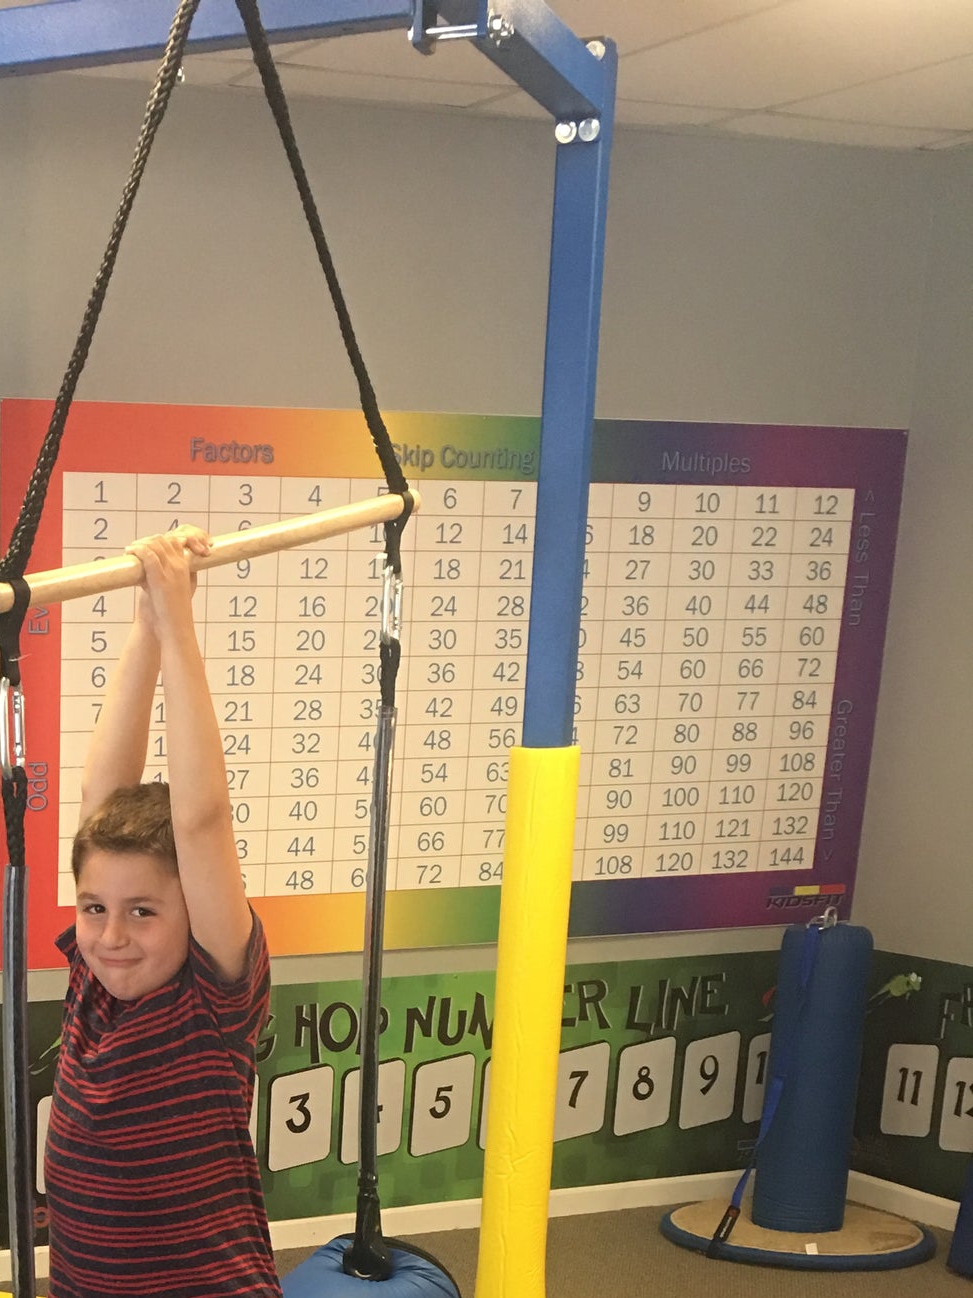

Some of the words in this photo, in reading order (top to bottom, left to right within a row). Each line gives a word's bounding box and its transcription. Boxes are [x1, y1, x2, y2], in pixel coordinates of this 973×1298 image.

[190, 437, 274, 464] Factors
[440, 443, 535, 475] Counting
[662, 451, 752, 476] Multiples
[95, 481, 108, 503] 1
[167, 482, 181, 504] 2
[239, 484, 252, 505] 3
[308, 485, 322, 506] 4
[444, 488, 456, 509] 6
[511, 489, 522, 509] 7
[639, 492, 651, 512] 9
[696, 493, 720, 513] 10
[755, 494, 779, 513] 11
[814, 495, 838, 514] 12
[94, 518, 107, 540] 2
[436, 523, 462, 543] 12
[503, 524, 527, 544] 14
[629, 525, 654, 545] 18
[692, 526, 718, 546] 20
[751, 527, 777, 546] 22
[810, 528, 832, 547] 24
[855, 512, 875, 563] Less
[237, 558, 250, 579] 9
[300, 558, 328, 579] 12
[434, 559, 460, 579] 18
[499, 559, 525, 579] 21
[626, 560, 650, 579] 27
[689, 560, 715, 580] 30
[748, 561, 773, 580] 33
[807, 561, 831, 580] 36
[92, 596, 107, 617] 4
[229, 596, 257, 617] 12
[299, 596, 325, 617] 16
[431, 596, 457, 616] 24
[497, 596, 524, 616] 28
[622, 596, 648, 615] 36
[685, 596, 711, 615] 40
[744, 595, 769, 613] 44
[803, 595, 827, 614] 48
[849, 573, 869, 626] Than
[28, 606, 49, 635] Ev
[91, 631, 107, 652] 5
[228, 631, 255, 651] 15
[296, 630, 325, 651] 20
[429, 629, 456, 649] 30
[495, 629, 521, 649] 35
[620, 628, 645, 647] 45
[683, 627, 708, 647] 50
[742, 627, 766, 646] 55
[800, 627, 824, 646] 60
[92, 667, 106, 688] 6
[227, 665, 254, 686] 18
[295, 664, 322, 685] 24
[428, 663, 455, 683] 36
[493, 662, 520, 681] 42
[618, 660, 643, 680] 54
[680, 660, 705, 679] 60
[739, 659, 763, 678] 66
[798, 658, 821, 677] 72
[92, 704, 103, 724] 7
[224, 701, 252, 722] 21
[294, 700, 322, 720] 28
[425, 698, 452, 717] 42
[491, 696, 517, 716] 49
[615, 694, 640, 713] 63
[679, 693, 702, 712] 70
[738, 692, 759, 710] 77
[793, 691, 816, 709] 84
[224, 734, 251, 755] 24
[292, 733, 320, 754] 32
[423, 730, 451, 750] 48
[489, 728, 515, 748] 56
[614, 725, 637, 744] 72
[674, 724, 699, 743] 80
[732, 722, 757, 741] 88
[790, 721, 814, 740] 96
[829, 699, 852, 781] Greater
[27, 761, 48, 811] Odd
[227, 770, 249, 790] 27
[291, 768, 319, 788] 36
[421, 763, 448, 783] 54
[487, 762, 509, 782] 63
[609, 759, 633, 777] 81
[672, 755, 696, 775] 90
[727, 754, 751, 773] 99
[780, 753, 815, 771] 108
[289, 801, 317, 821] 40
[420, 796, 447, 816] 60
[607, 790, 632, 809] 90
[662, 787, 699, 807] 100
[719, 785, 754, 804] 110
[777, 782, 813, 801] 120
[822, 788, 843, 840] Than
[287, 837, 315, 856] 44
[418, 832, 444, 851] 66
[482, 829, 505, 848] 77
[604, 824, 628, 843] 99
[659, 821, 695, 840] 110
[715, 819, 750, 838] 121
[773, 816, 808, 835] 132
[286, 870, 313, 890] 48
[417, 865, 442, 884] 72
[478, 861, 504, 882] 84
[595, 855, 632, 875] 108
[656, 852, 693, 872] 120
[712, 850, 748, 869] 132
[770, 847, 804, 866] 144
[404, 979, 611, 1054] NUMER
[626, 972, 729, 1035] LINE
[285, 1092, 312, 1134] 3
[429, 1085, 454, 1119] 5
[568, 1070, 589, 1109] 7
[632, 1065, 655, 1101] 8
[699, 1055, 719, 1096] 9
[755, 1051, 767, 1085] 1
[896, 1067, 923, 1106] 11
